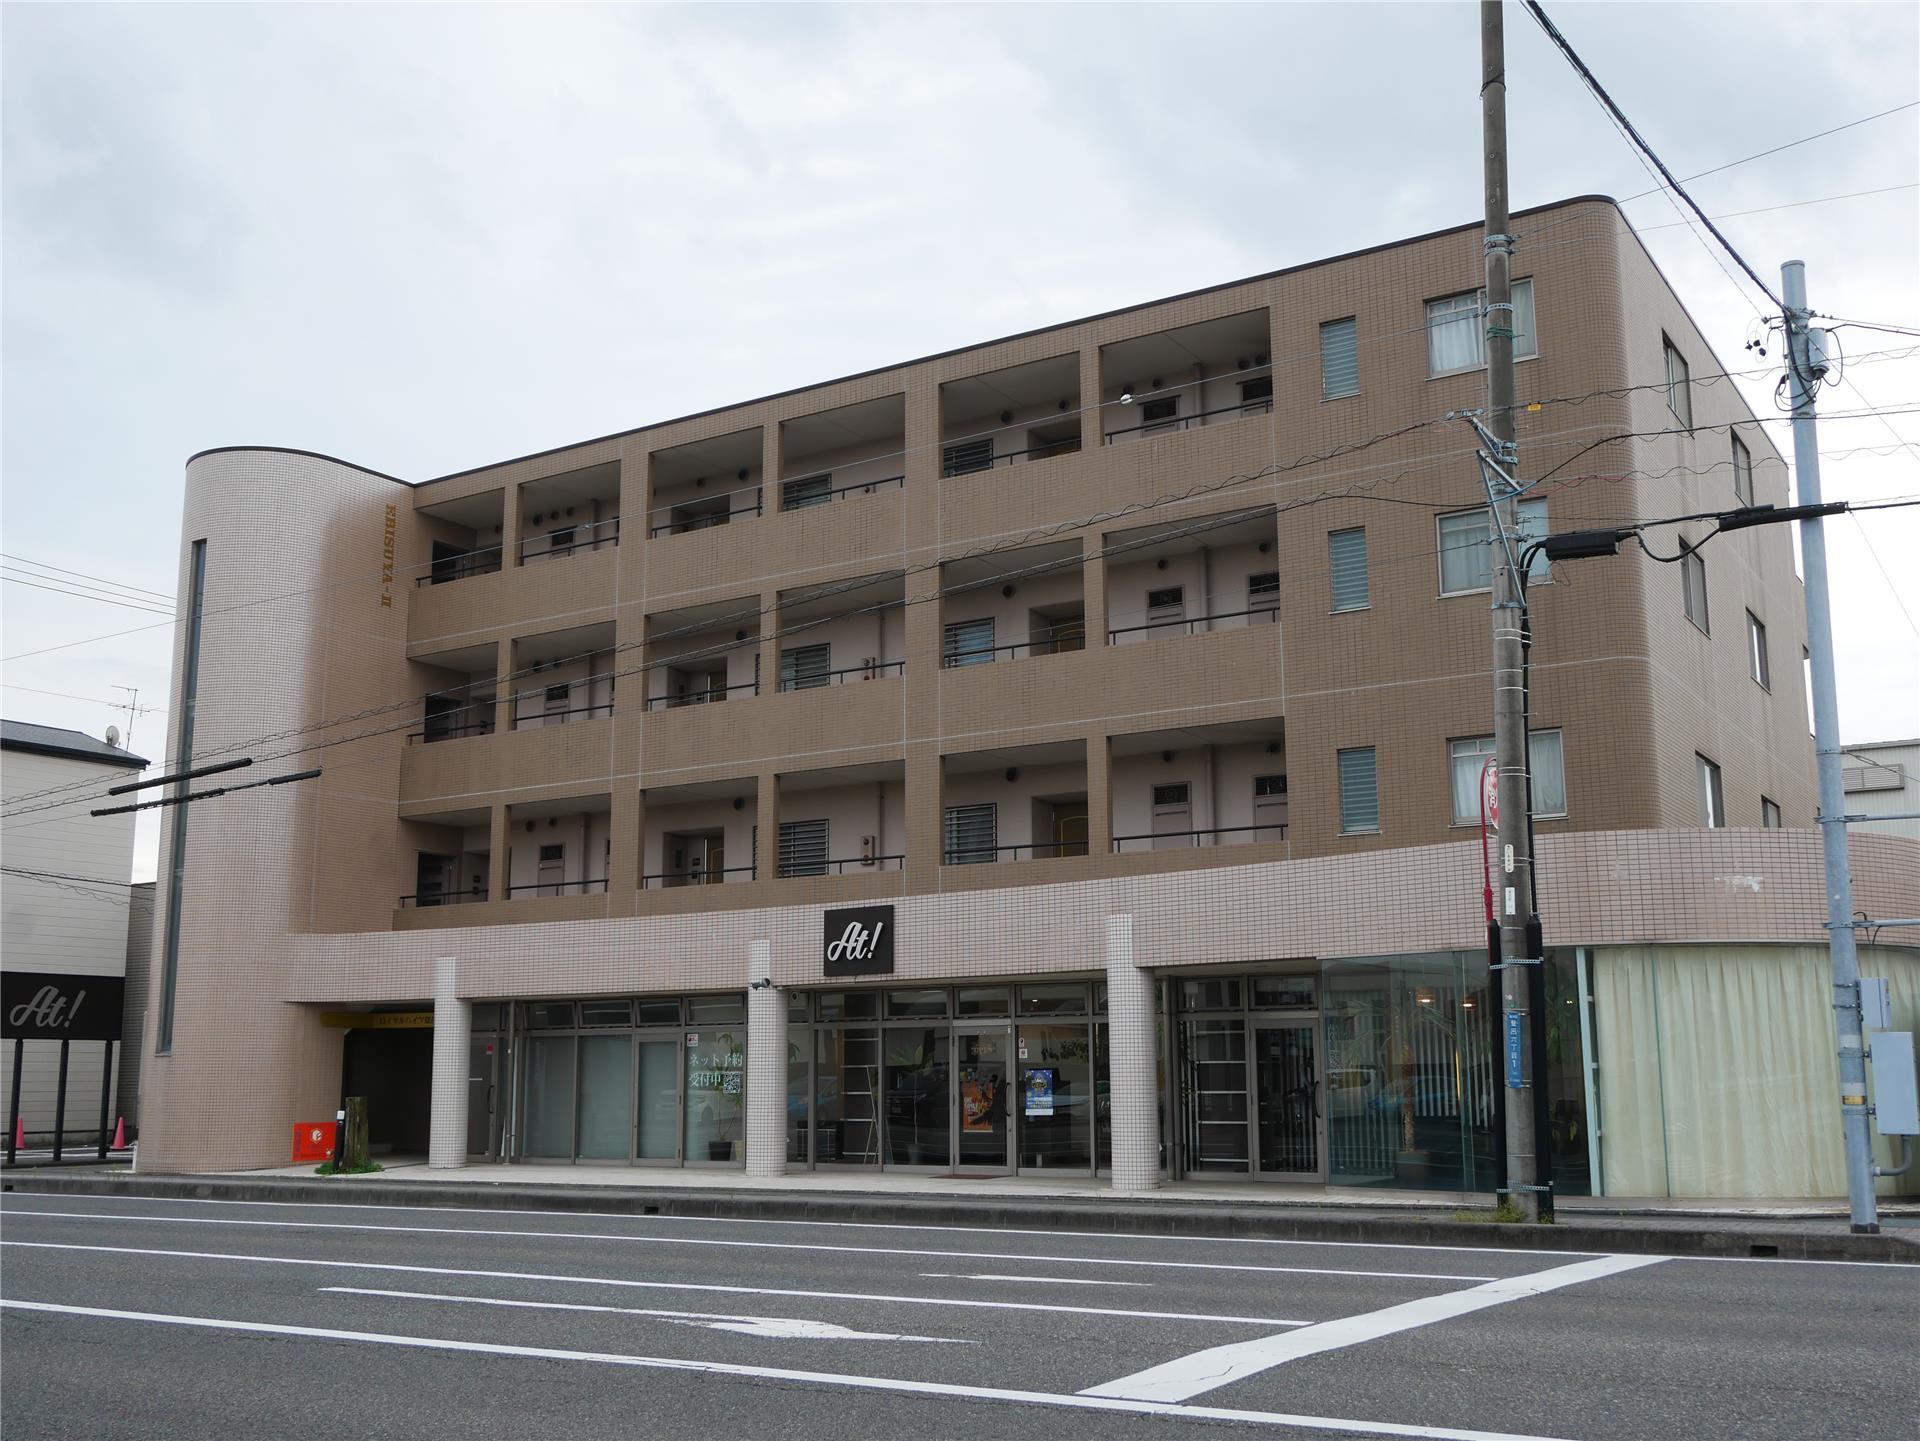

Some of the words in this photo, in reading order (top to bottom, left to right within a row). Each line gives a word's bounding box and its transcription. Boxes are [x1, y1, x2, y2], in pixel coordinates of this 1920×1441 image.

[827, 921, 884, 961] At!
[9, 984, 87, 1028] At!
[688, 1051, 743, 1067] ネット予約
[688, 1071, 721, 1087] 受付中
